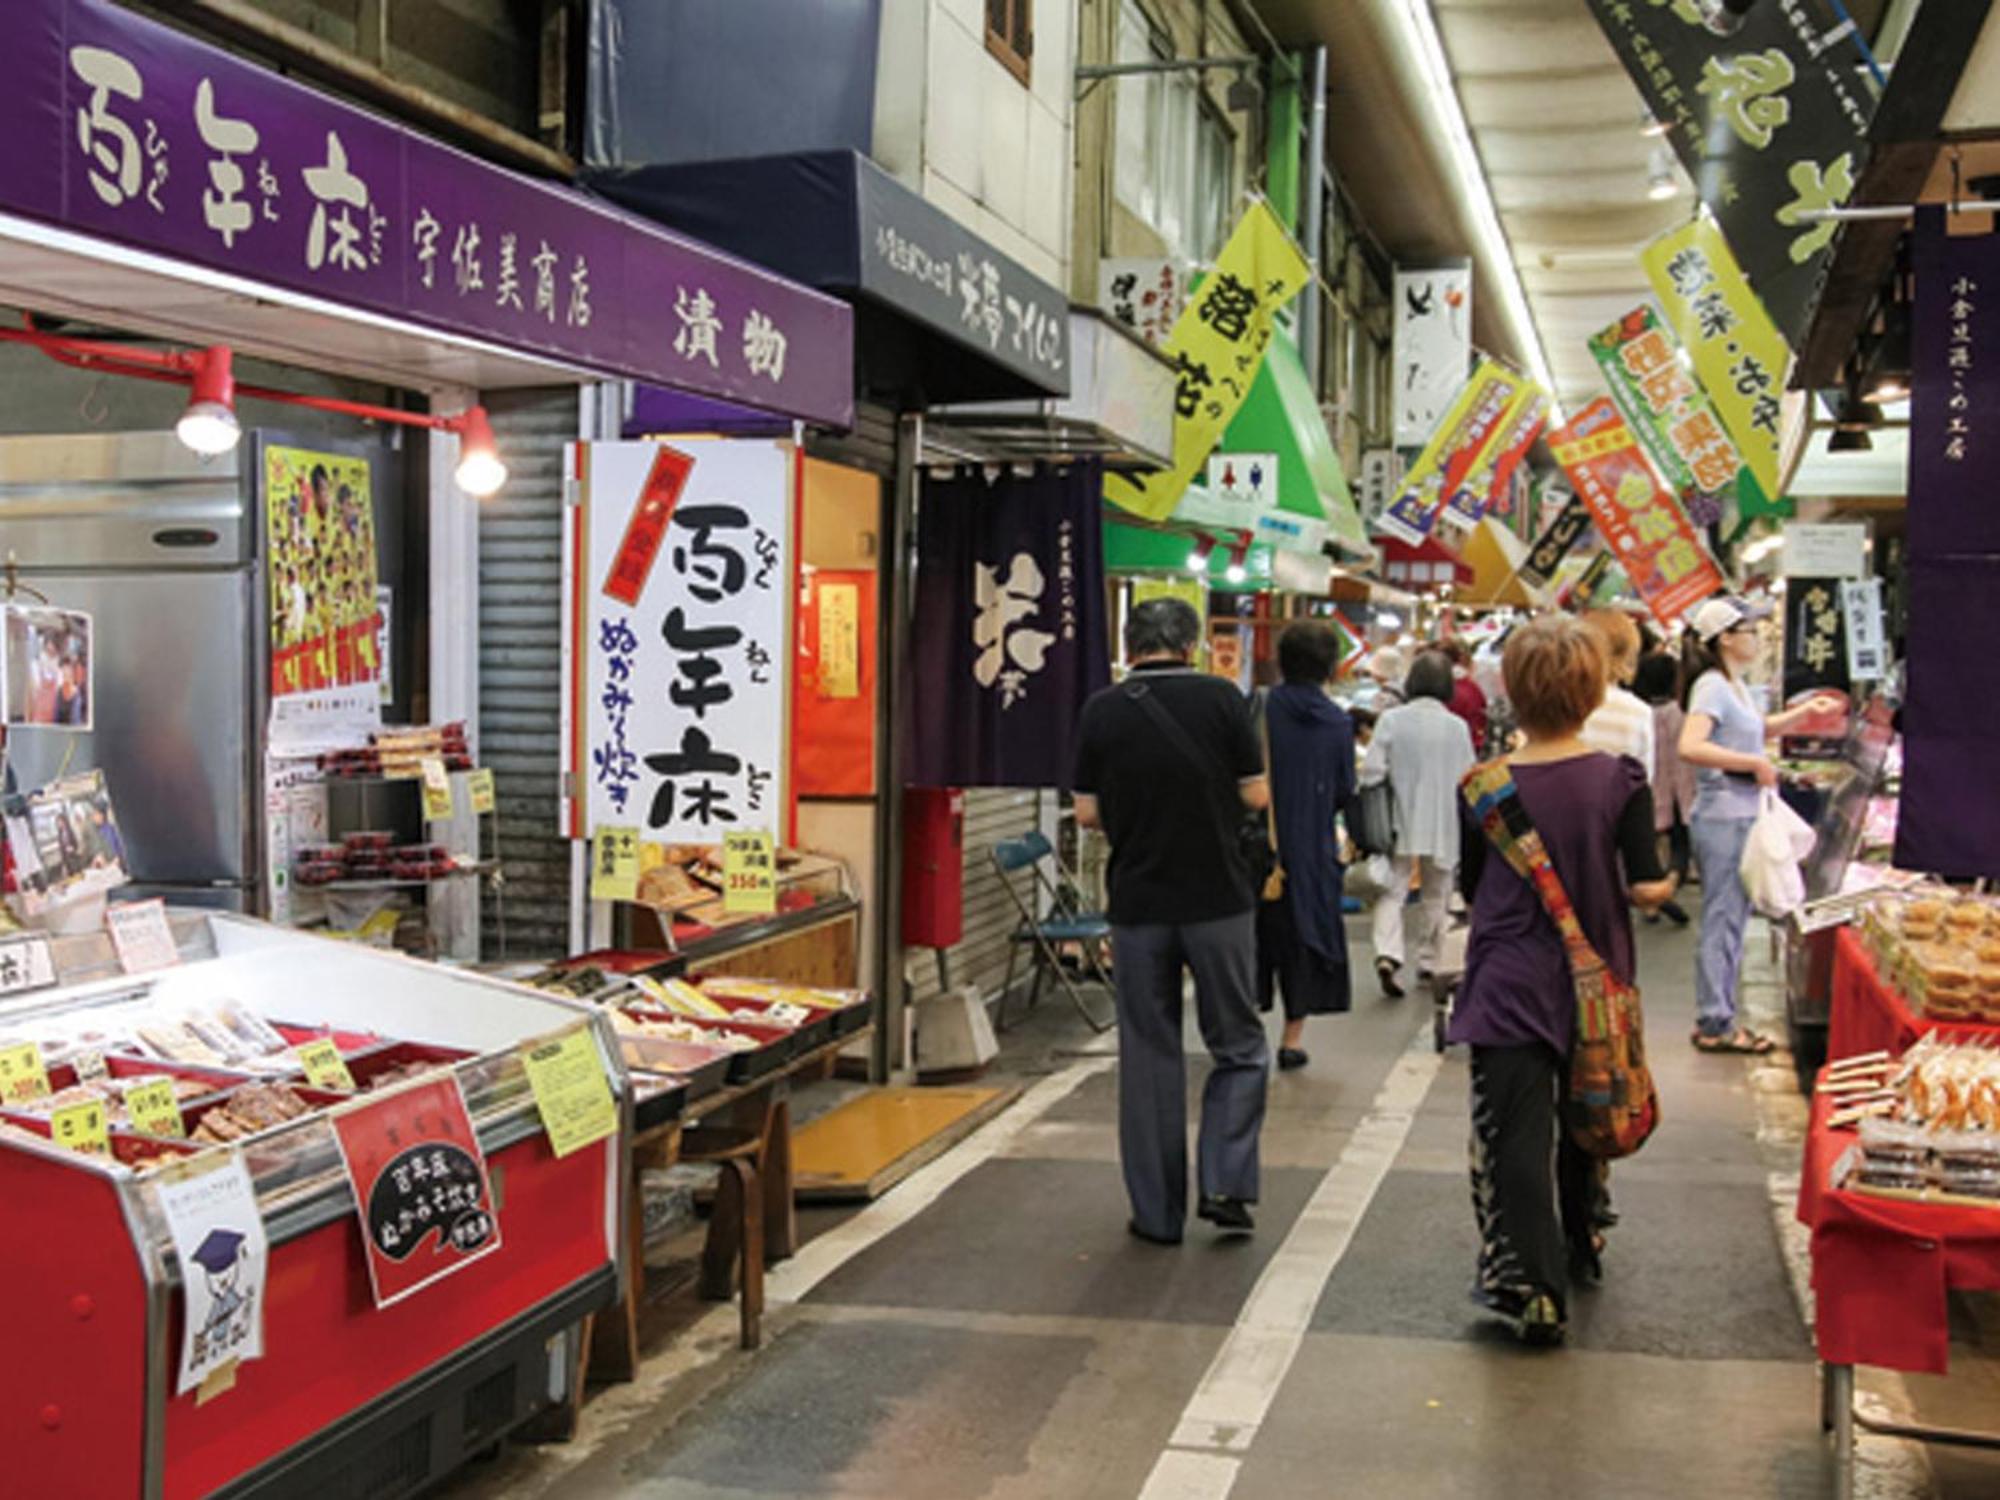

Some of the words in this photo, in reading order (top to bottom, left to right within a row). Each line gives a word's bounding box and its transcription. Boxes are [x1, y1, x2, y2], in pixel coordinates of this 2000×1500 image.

[68, 44, 369, 272] 百年床
[413, 207, 594, 327] 宇佐美商店
[672, 286, 789, 383] 漬物
[642, 503, 752, 829] 百年床
